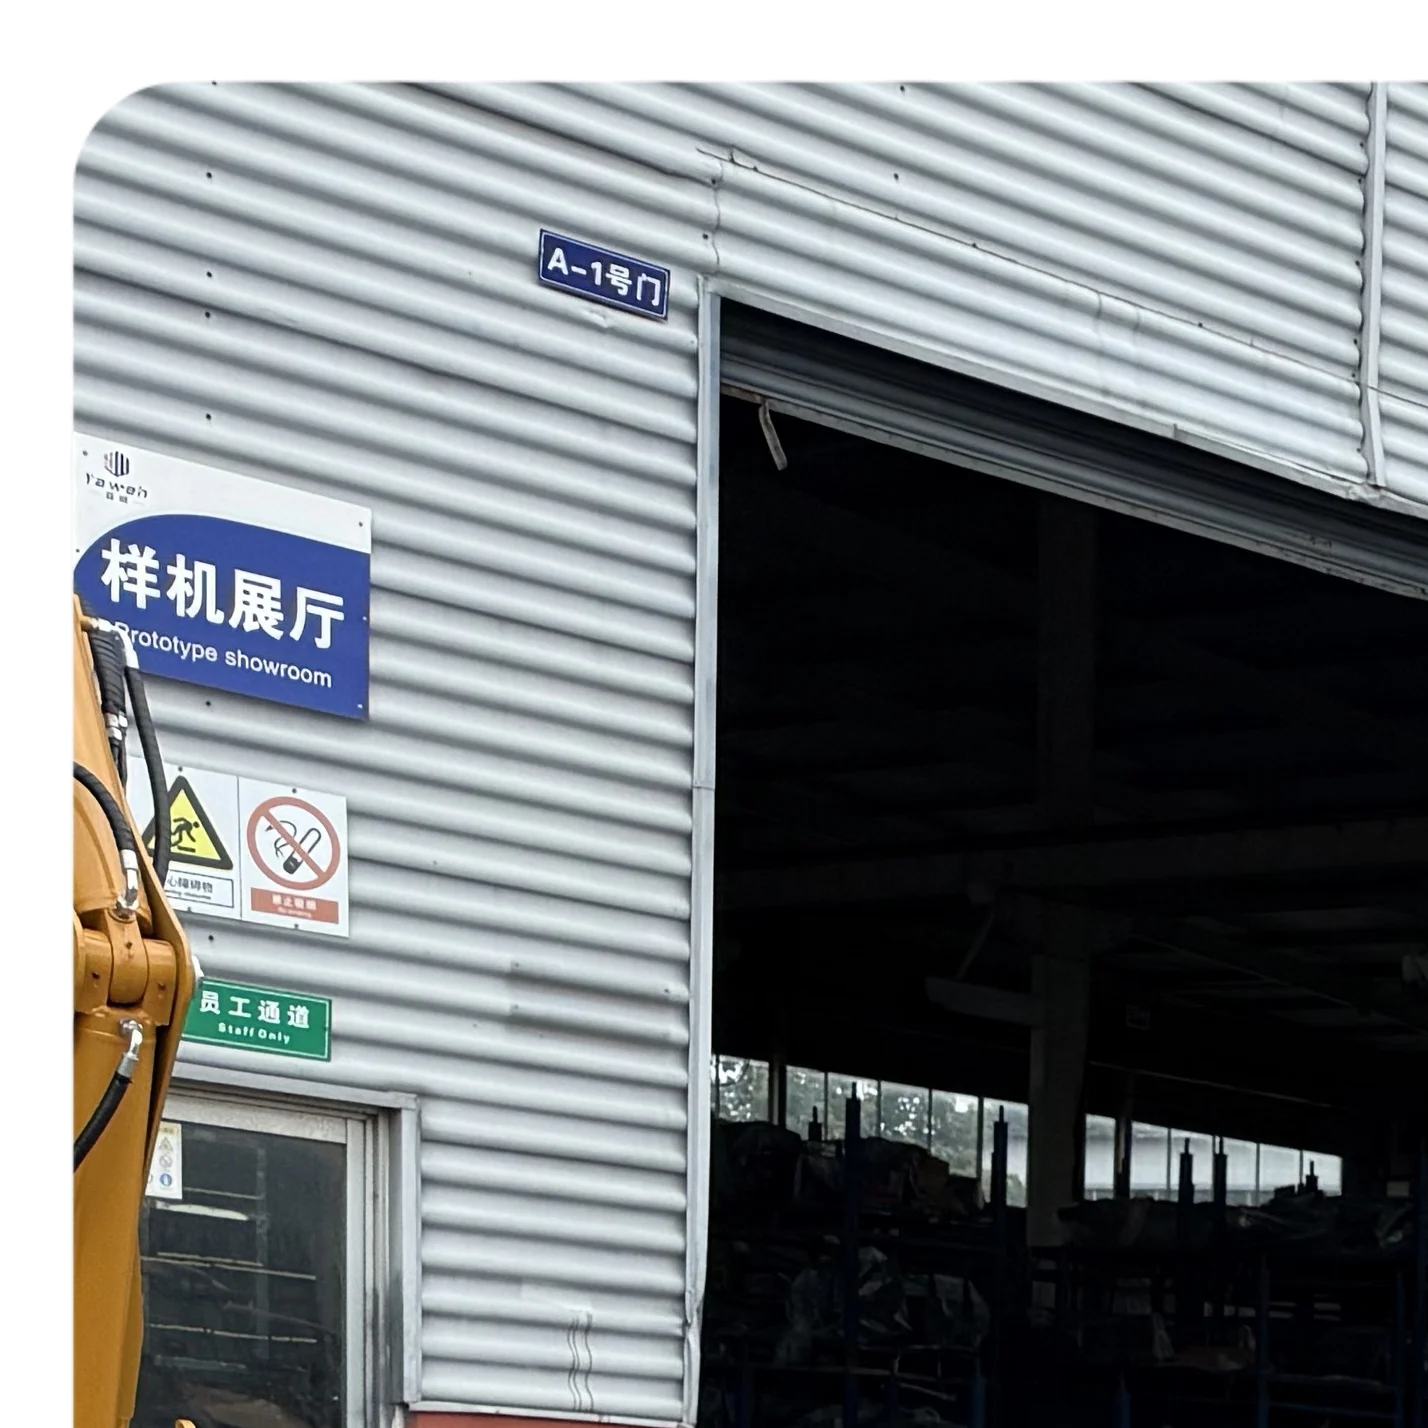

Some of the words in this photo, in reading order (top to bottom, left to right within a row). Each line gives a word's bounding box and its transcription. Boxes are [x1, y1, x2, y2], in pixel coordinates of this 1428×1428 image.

[547, 247, 661, 307] A-1号门
[101, 538, 345, 649] 样机展厅
[225, 649, 332, 689] showroom
[199, 990, 309, 1029] 员工通道
[218, 1022, 255, 1038] Staff
[257, 1028, 290, 1045] Only
